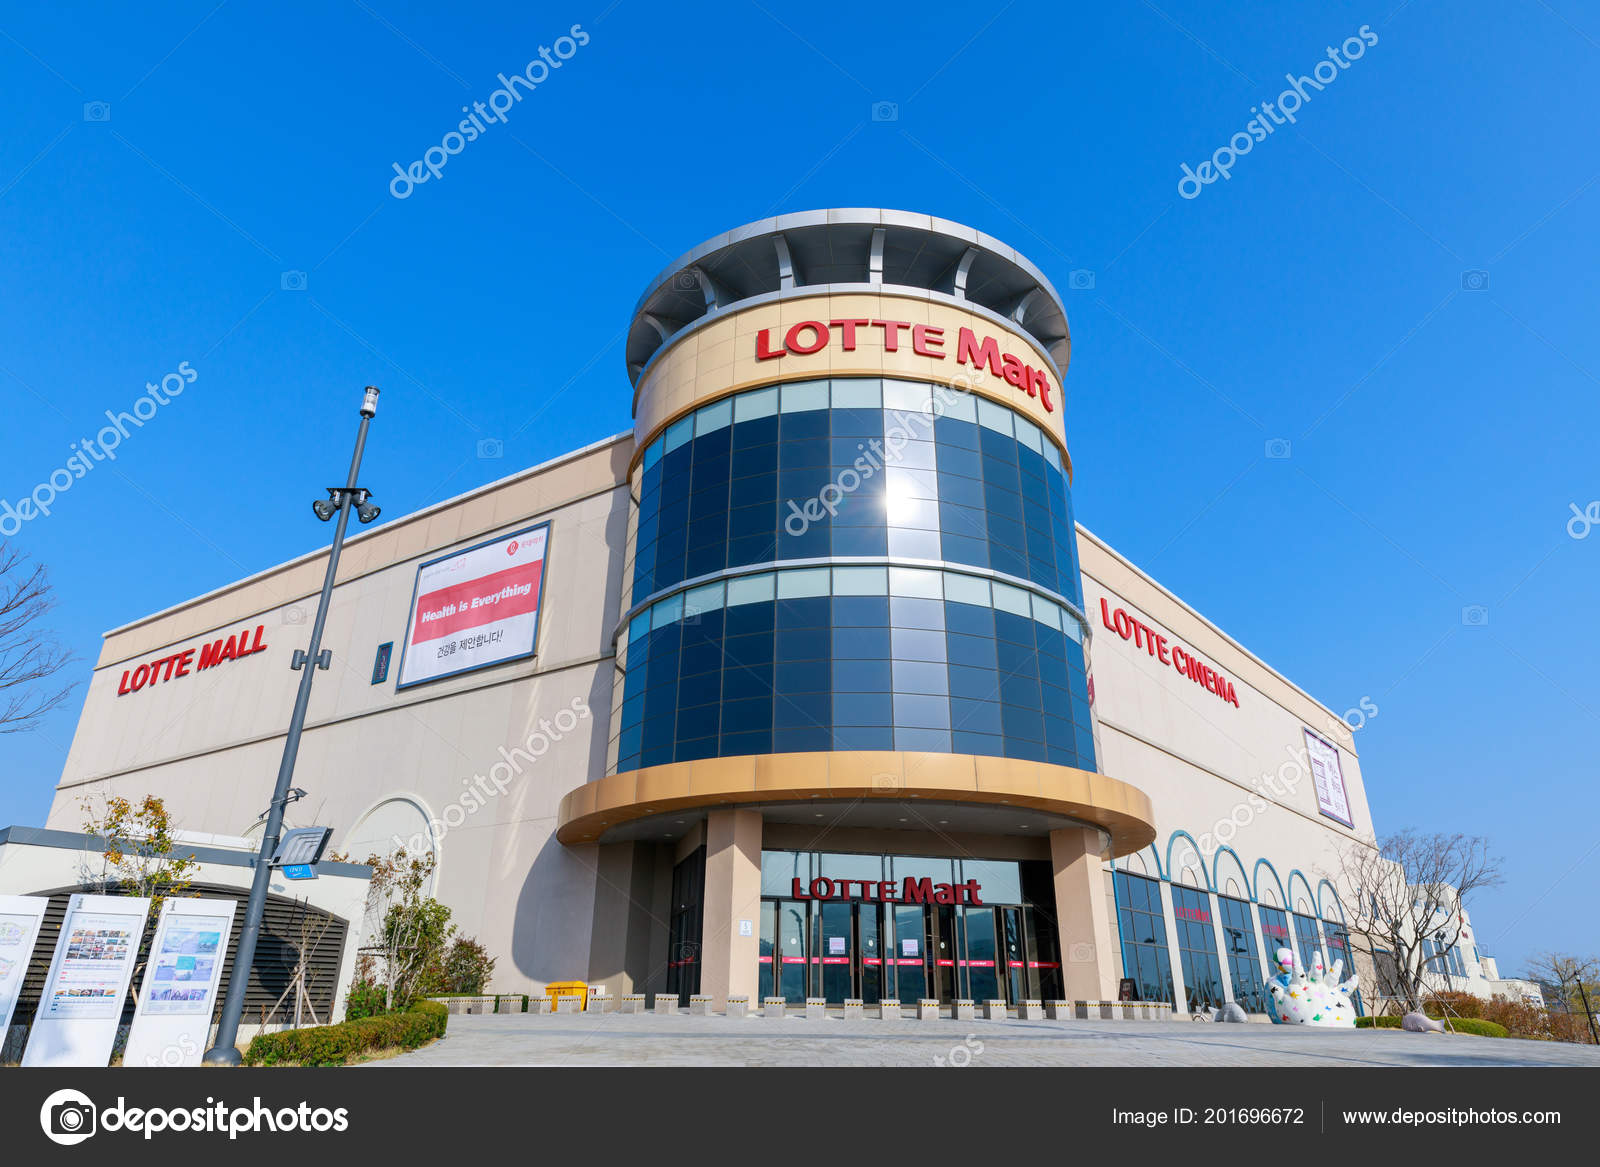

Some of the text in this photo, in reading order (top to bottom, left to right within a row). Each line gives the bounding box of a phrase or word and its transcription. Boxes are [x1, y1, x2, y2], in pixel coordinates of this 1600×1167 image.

[756, 318, 1054, 413] LOTTE Mart
[421, 582, 533, 624] Health is Everything
[117, 625, 268, 697] LOTTE MALL
[437, 629, 504, 659] 건강을 제안합니다!
[1100, 597, 1171, 666] LOTTE
[1172, 645, 1240, 709] CINEMA
[791, 876, 983, 906] LOTTE Mart
